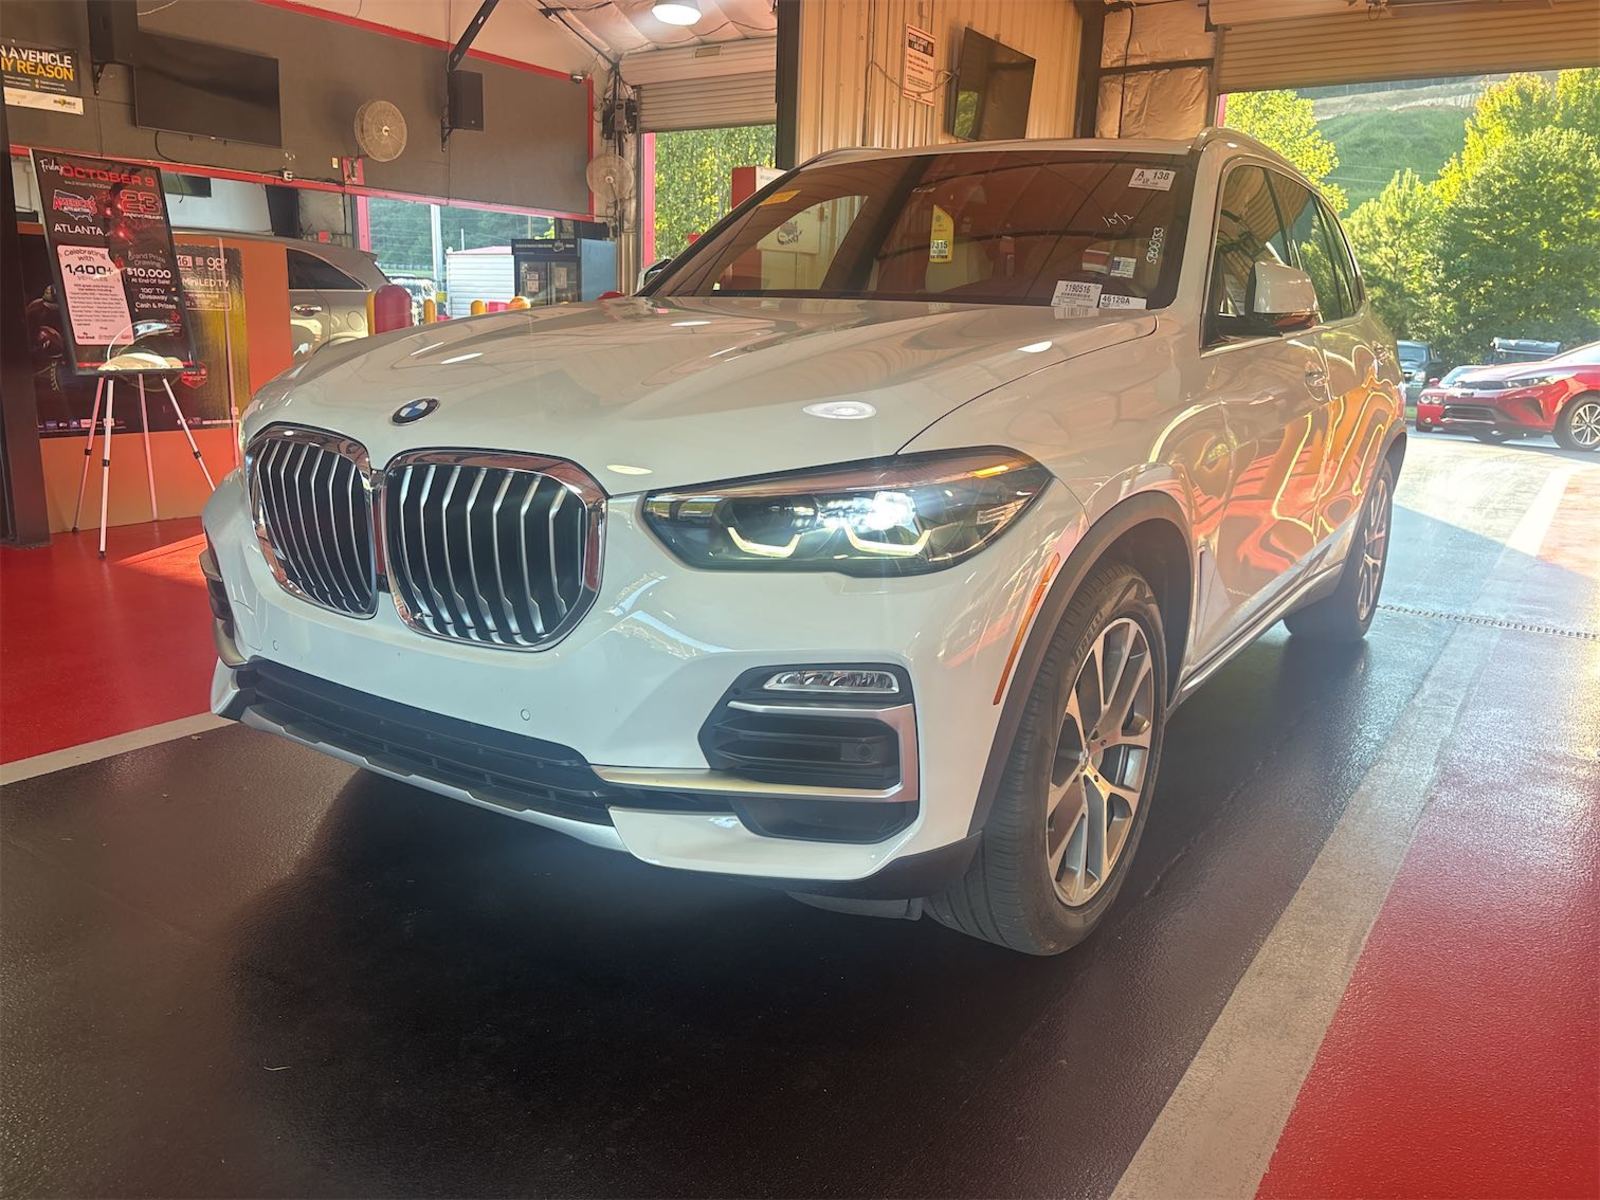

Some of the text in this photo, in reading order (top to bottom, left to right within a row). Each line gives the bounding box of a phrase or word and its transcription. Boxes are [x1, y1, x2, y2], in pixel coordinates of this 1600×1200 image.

[9, 47, 19, 60] A
[19, 48, 73, 69] VEHICLE
[16, 60, 75, 81] REASON
[40, 158, 64, 176] Friday
[62, 164, 142, 186] OCTOBER
[144, 176, 156, 188] 9
[120, 190, 162, 215] 23
[54, 223, 104, 236] ATLANTA
[64, 248, 106, 260] Celebrating
[65, 263, 114, 276] 1,400+
[126, 267, 172, 279] $10,000
[138, 293, 168, 302] Giveaway
[135, 301, 151, 309] Cash
